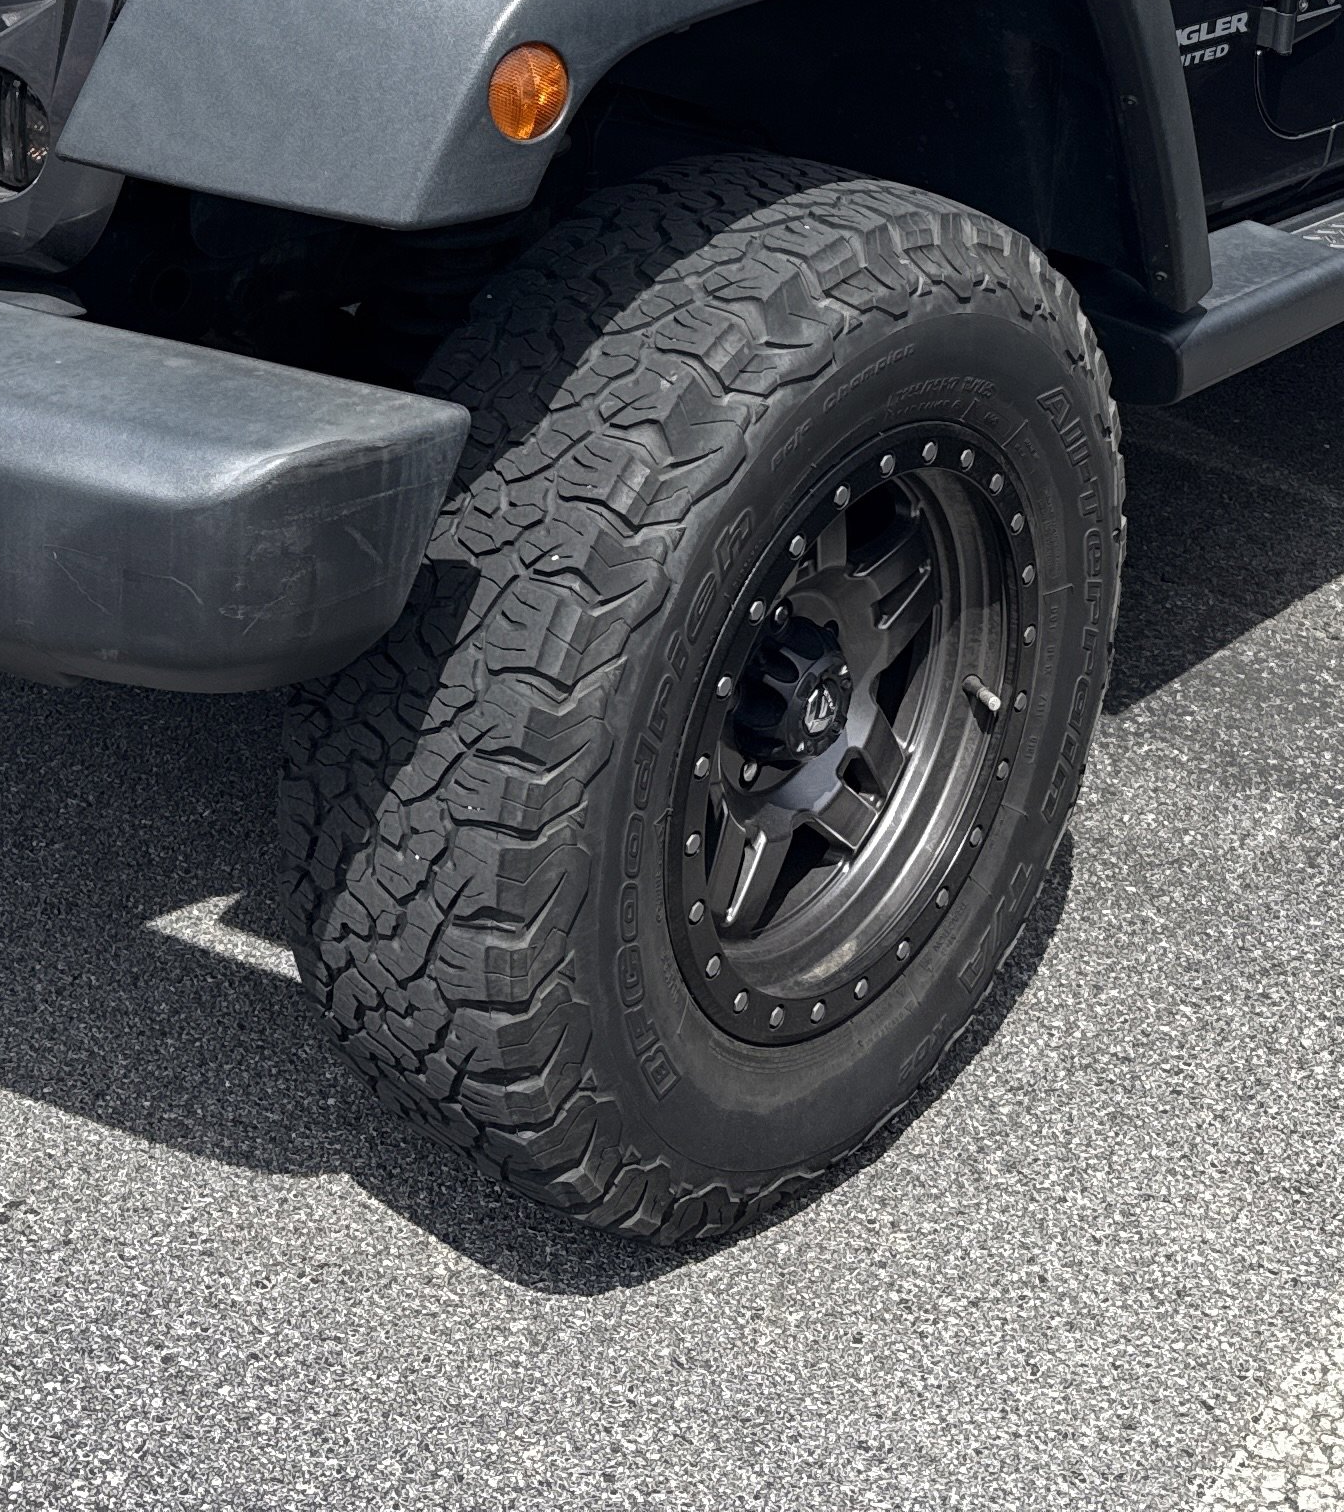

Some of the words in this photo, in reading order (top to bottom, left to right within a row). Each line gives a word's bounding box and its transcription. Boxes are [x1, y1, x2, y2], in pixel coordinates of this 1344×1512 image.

[617, 505, 755, 1102] BFGoodrich
[1034, 385, 1106, 826] All-Terrain
[958, 861, 1033, 995] T/A
